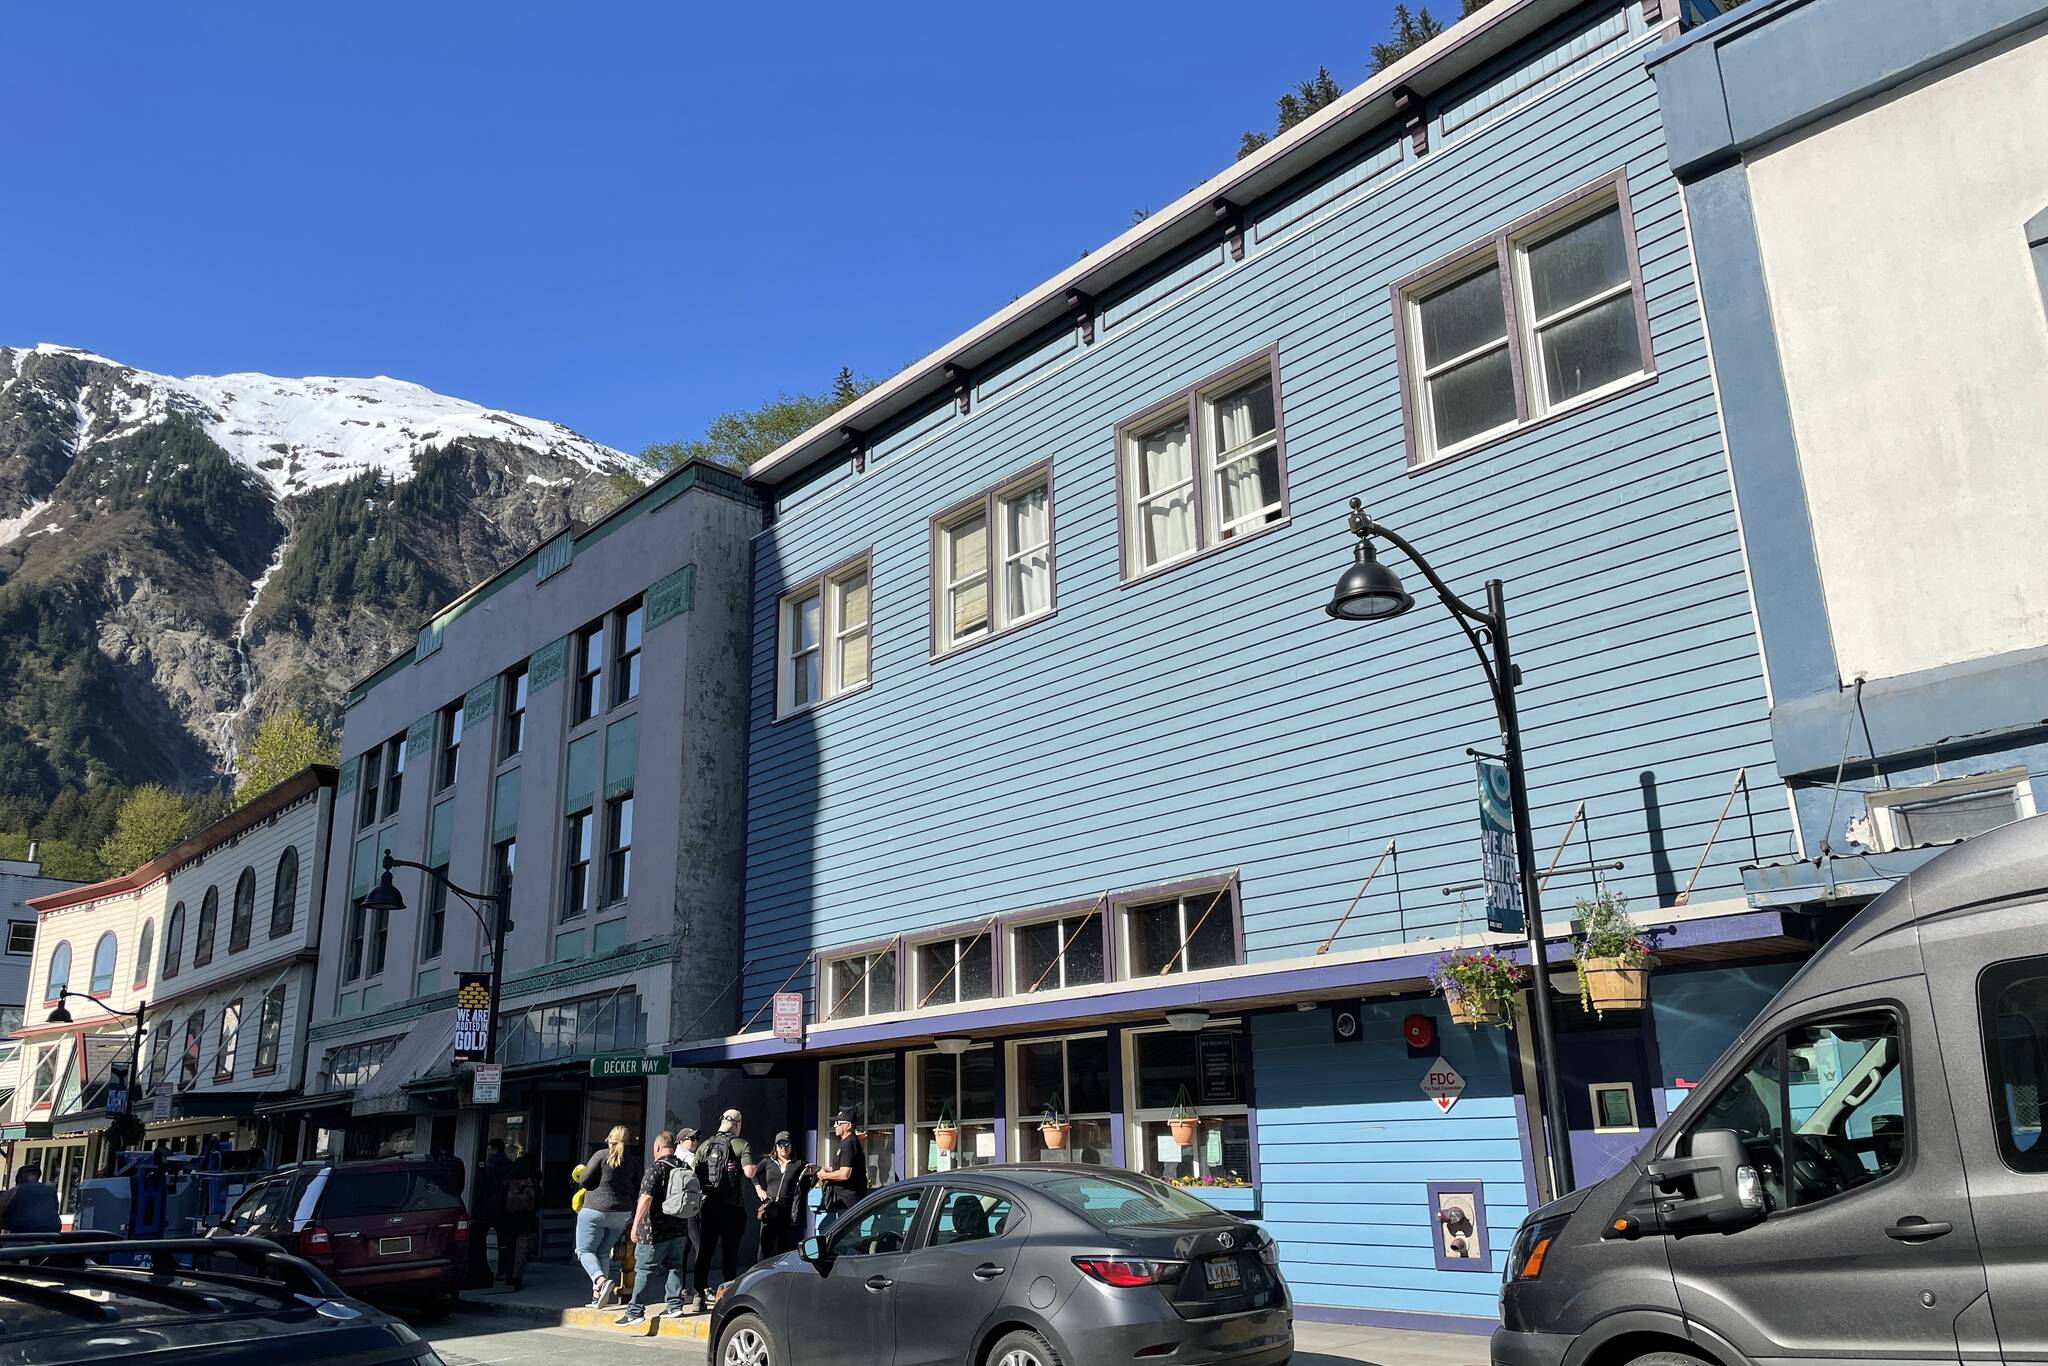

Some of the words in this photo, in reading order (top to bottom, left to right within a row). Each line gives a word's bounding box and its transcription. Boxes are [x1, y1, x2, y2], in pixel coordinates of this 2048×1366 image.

[1482, 830, 1498, 853] WE
[1483, 853, 1516, 884] WATER
[1484, 880, 1522, 911] PEOPLE
[457, 1008, 470, 1021] WE
[472, 1008, 488, 1021] ARE
[455, 1021, 480, 1031] ROOTED
[480, 1021, 488, 1032] IN
[454, 1031, 487, 1051] GOLD
[603, 1060, 637, 1074] DECKER
[641, 1060, 659, 1073] WAY
[1430, 1072, 1455, 1085] FDC
